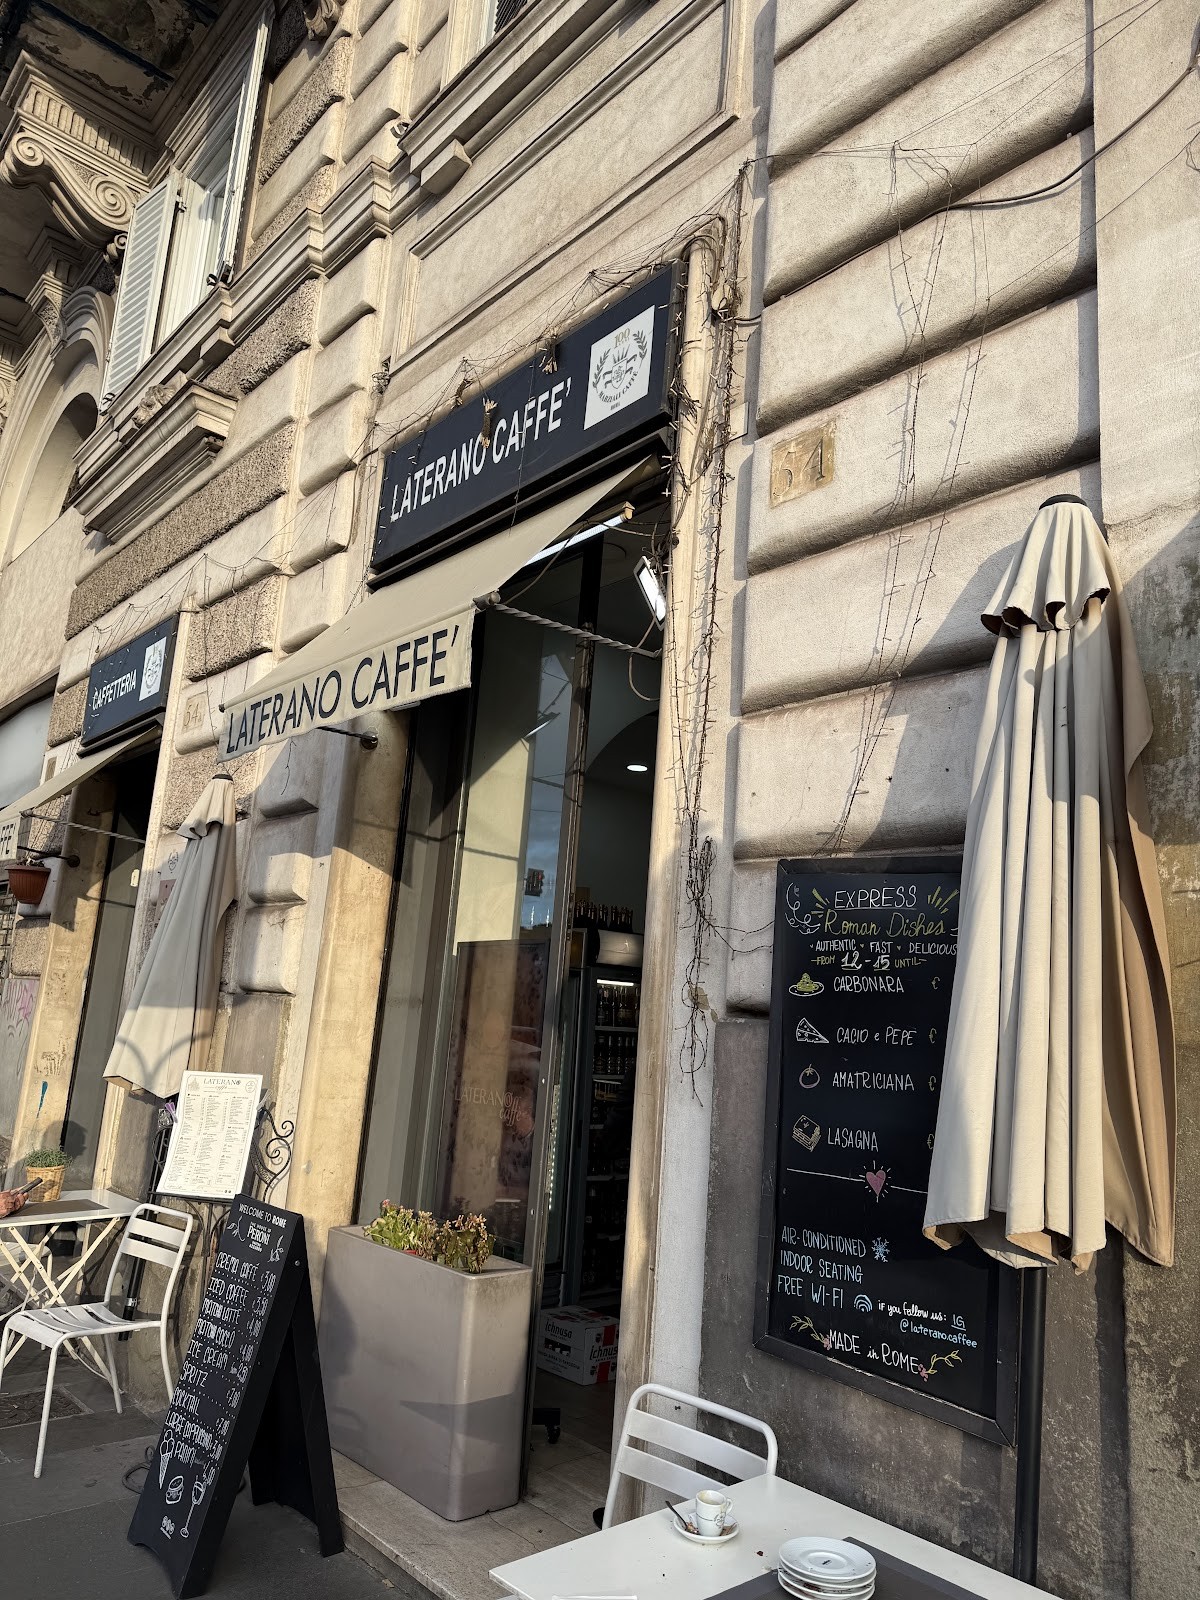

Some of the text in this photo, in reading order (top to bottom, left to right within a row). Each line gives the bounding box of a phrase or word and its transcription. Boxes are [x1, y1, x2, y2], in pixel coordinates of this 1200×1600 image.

[614, 328, 631, 349] 100
[390, 377, 572, 523] LATERANO CAFFE'
[773, 438, 826, 497] 54
[92, 668, 137, 711] CAFFETTERIA
[226, 624, 460, 754] LATERANO CAFFE'
[833, 885, 918, 910] EXPRESS
[824, 908, 948, 937] Roman Dishes
[815, 939, 958, 956] AUTHENTIC FAST DELICIOUS
[815, 955, 836, 966] FROM
[833, 976, 905, 993] CARBONARA
[836, 1027, 869, 1044] CACIO
[885, 1026, 917, 1046] PEPE
[832, 1071, 915, 1091] AMATRICIANA
[455, 1085, 513, 1108] LATERANO
[827, 1127, 879, 1152] LASAGNA
[239, 1203, 287, 1228] WELCOME TO ROME
[247, 1225, 270, 1245] PERONI
[780, 1250, 864, 1284] INDOOR SEATING
[208, 1276, 226, 1296] ICED
[225, 1283, 250, 1307] COFFEE
[777, 1274, 843, 1309] FREE WI-FI
[887, 1304, 902, 1317] you
[902, 1301, 929, 1319] follow
[187, 1339, 203, 1358] ICE
[203, 1346, 229, 1371] CREAM
[829, 1329, 920, 1374] MADE in ROME
[180, 1360, 209, 1388] SPRITZ
[172, 1386, 200, 1416] COCKTAIL
[165, 1410, 186, 1435] LARGE
